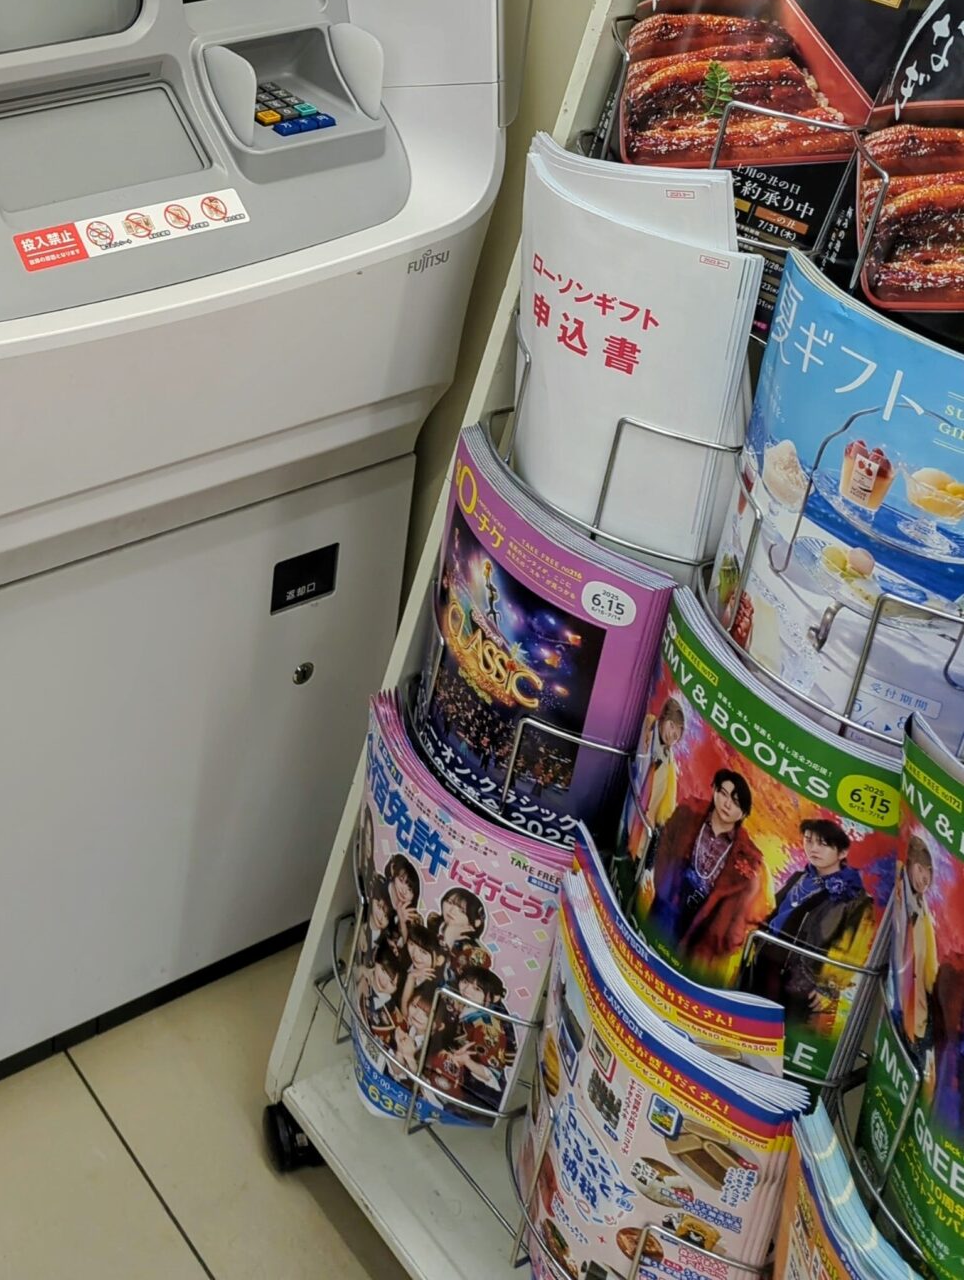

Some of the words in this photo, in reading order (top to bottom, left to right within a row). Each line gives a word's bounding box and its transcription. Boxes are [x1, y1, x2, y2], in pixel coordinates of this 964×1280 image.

[20, 230, 75, 252] 投入禁止
[407, 249, 450, 274] FUJITSU
[532, 252, 660, 331] ローソンギフト
[532, 292, 642, 376] 申込書
[591, 593, 626, 617] 6.15
[602, 589, 620, 602] 2025
[870, 682, 928, 712] 受付期間
[662, 628, 693, 686] HMV
[691, 684, 708, 710] &
[710, 702, 831, 800] BOOKS
[849, 788, 892, 814] 6.15
[864, 783, 885, 797] 2025
[935, 813, 955, 844] &
[510, 856, 534, 875] TAKE
[537, 866, 562, 886] FREE
[450, 859, 556, 926] に行こう!
[615, 914, 649, 962] LAWSON
[603, 985, 644, 1041] LAWSON
[880, 1037, 909, 1106] Mrs
